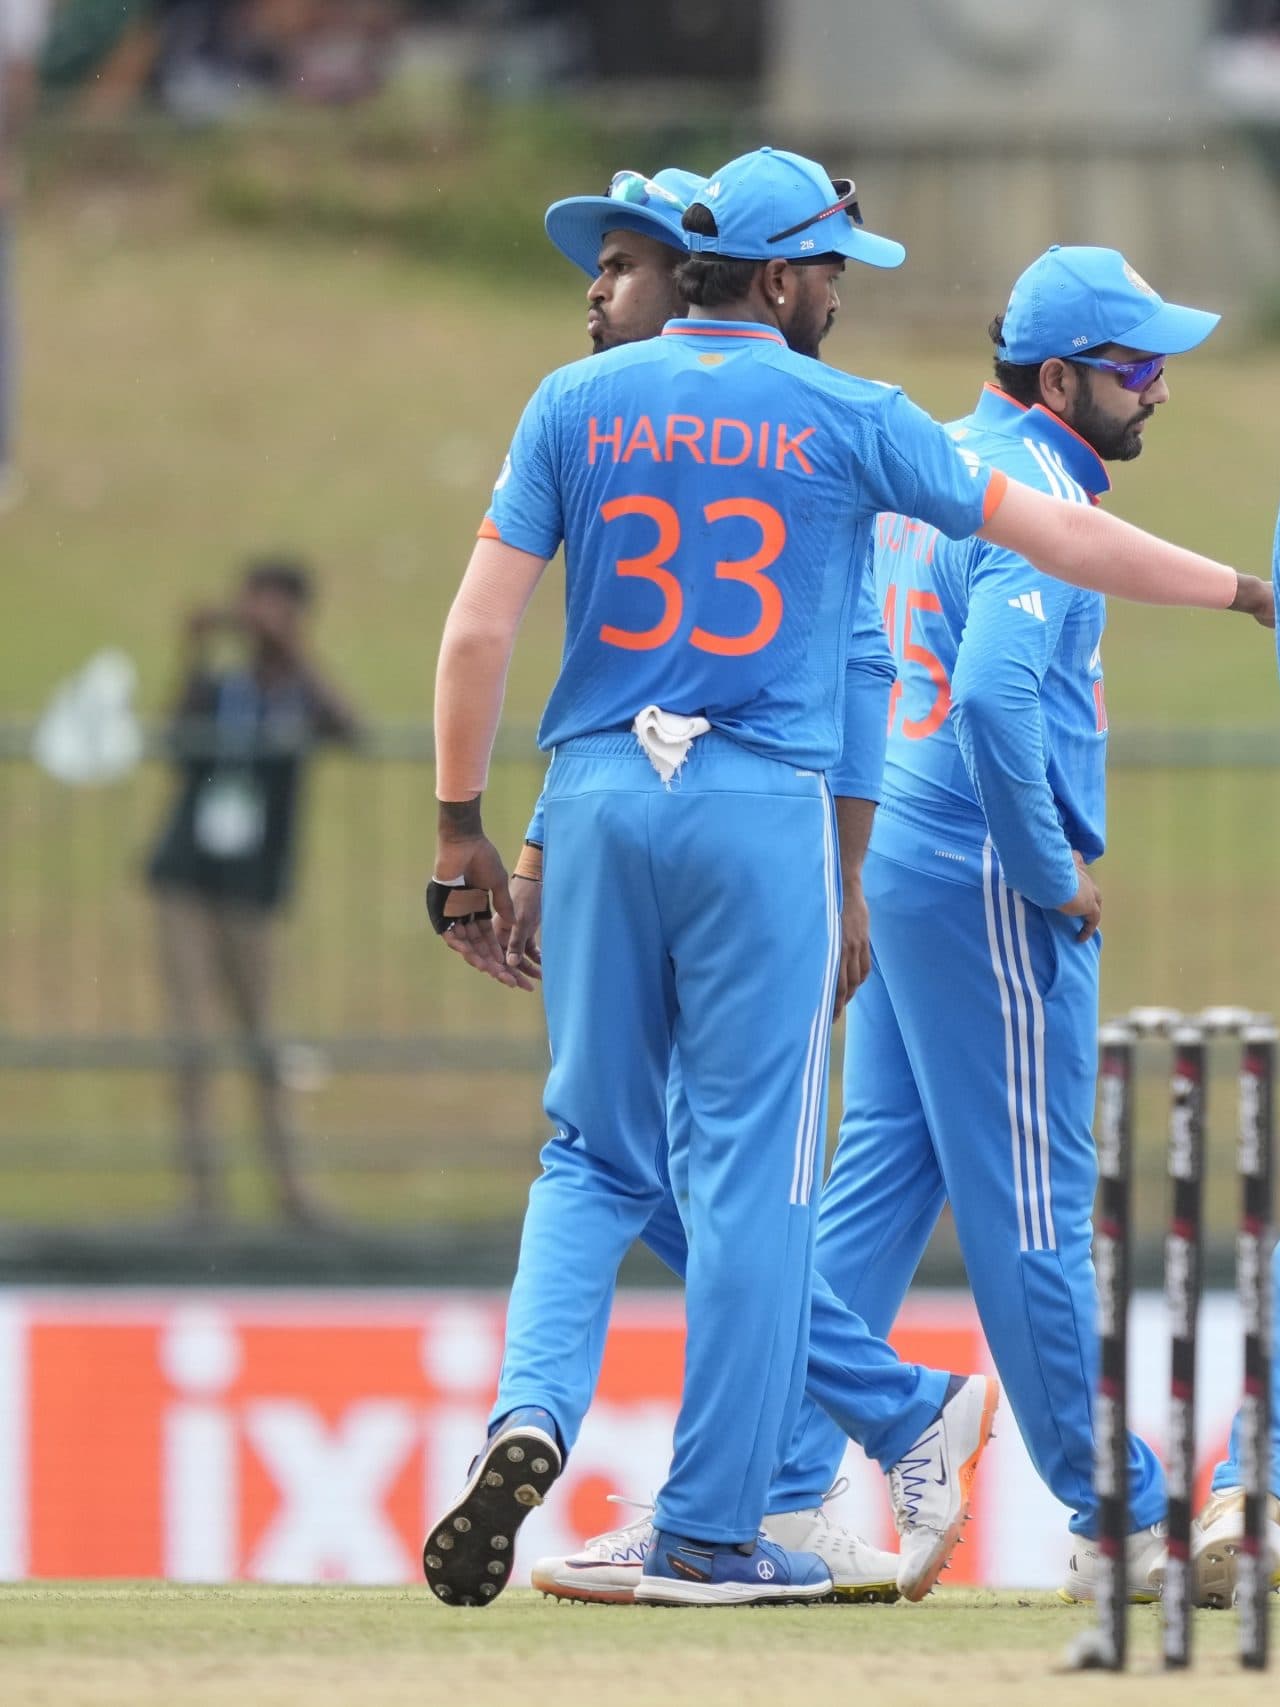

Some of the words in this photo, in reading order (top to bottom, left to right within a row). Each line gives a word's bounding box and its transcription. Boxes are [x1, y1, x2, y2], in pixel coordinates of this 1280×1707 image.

[800, 239, 815, 250] 215
[1072, 335, 1088, 348] 168
[587, 413, 817, 475] HARDIK
[599, 495, 787, 658] 33
